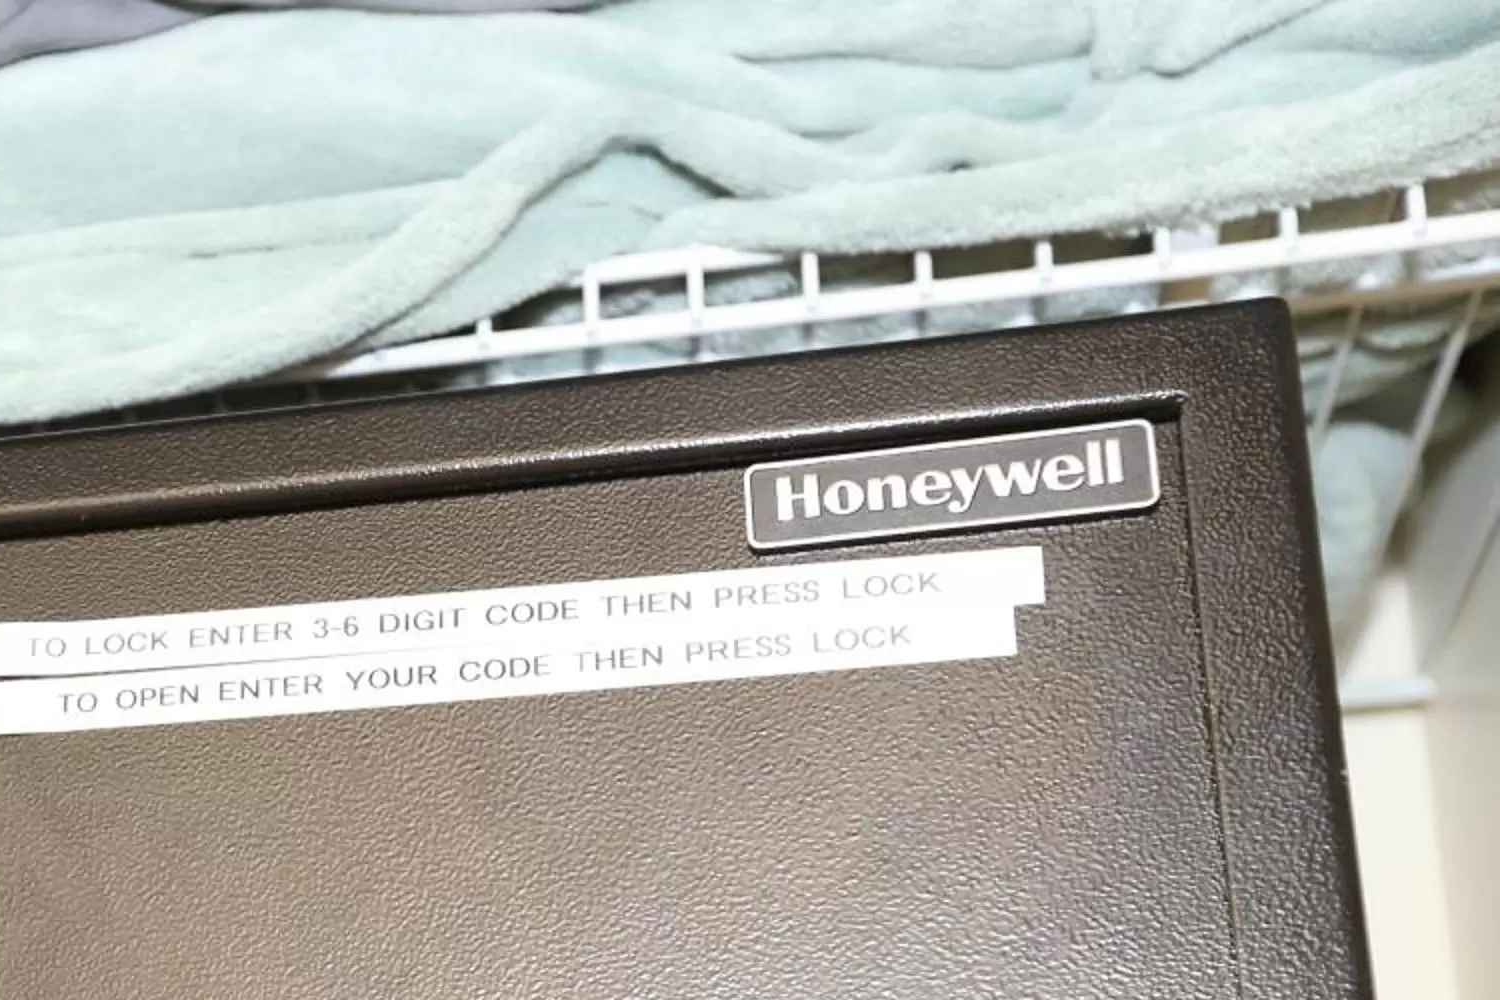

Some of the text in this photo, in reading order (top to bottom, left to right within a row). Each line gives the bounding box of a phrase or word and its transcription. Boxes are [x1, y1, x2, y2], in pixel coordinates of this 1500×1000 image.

[775, 438, 1124, 521] Honeywell
[26, 571, 943, 659] TO LOCK ENTER 3-6 DIGIT CODE THEN PRESS LOCK
[58, 624, 912, 714] TO OPEN ENTER YOUR CODE THEN PRESS LOCK
